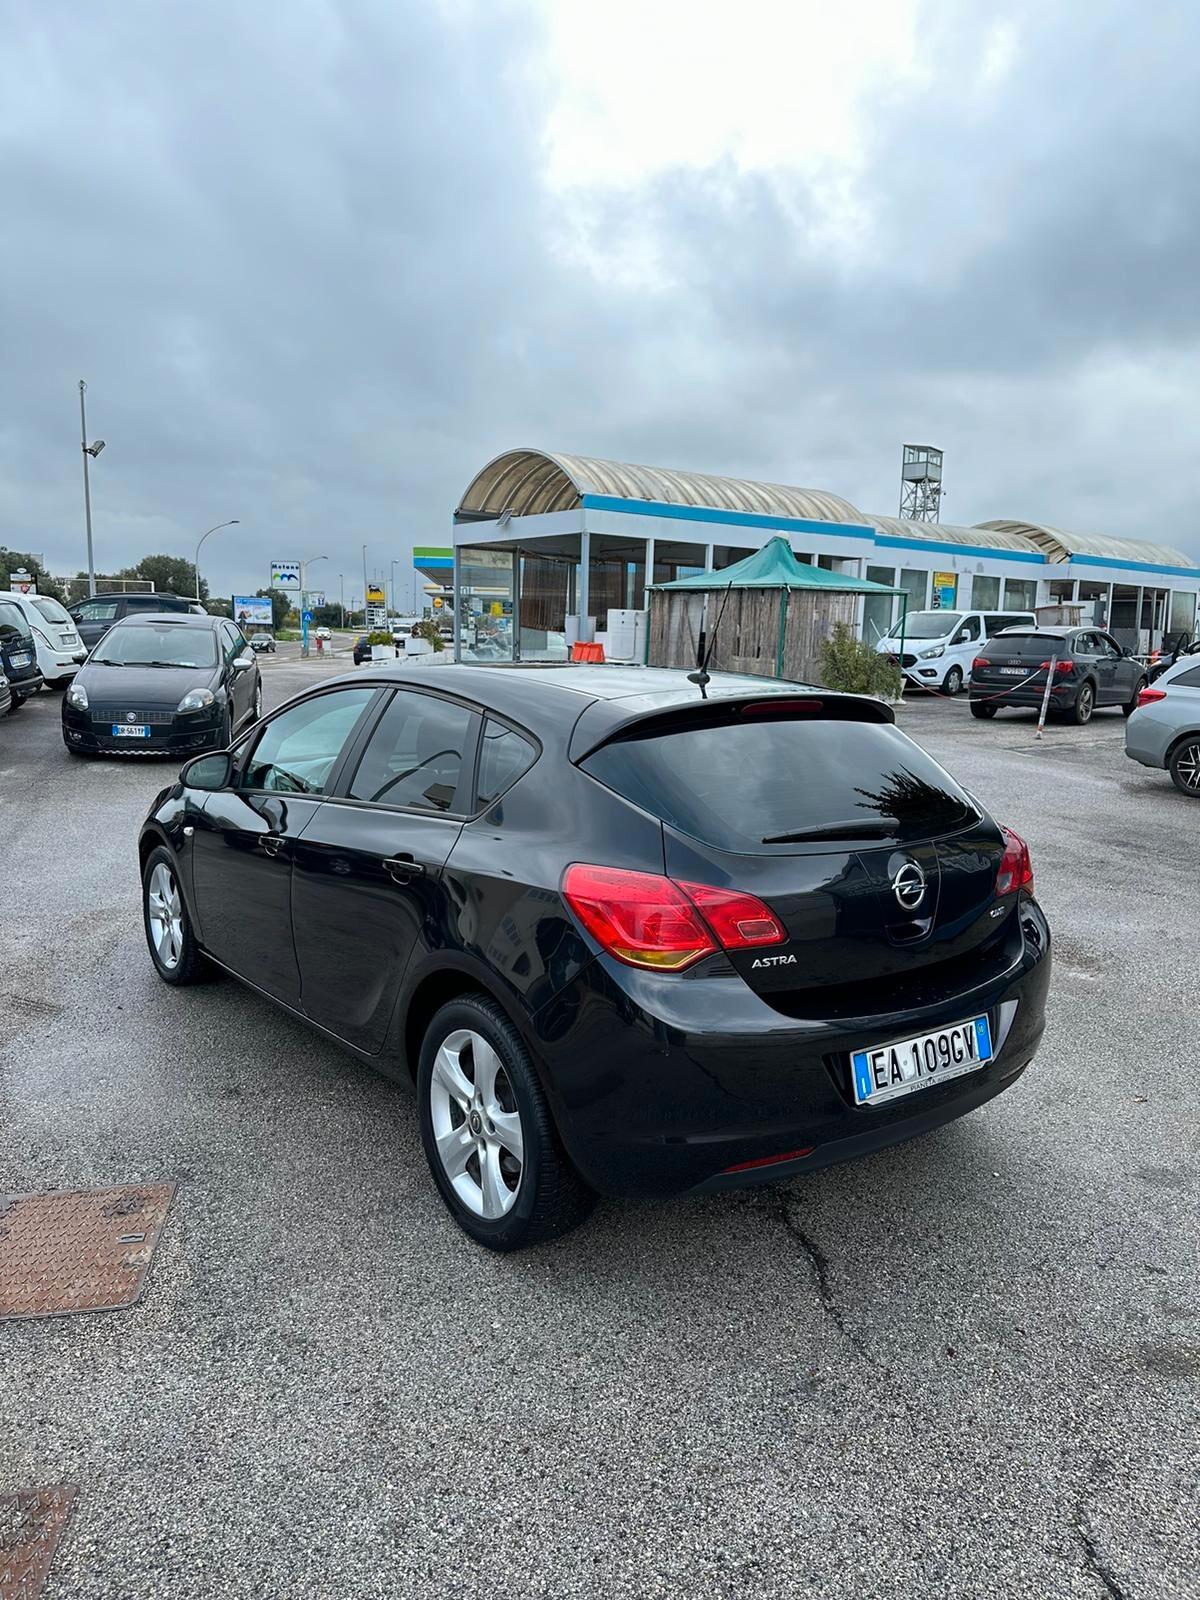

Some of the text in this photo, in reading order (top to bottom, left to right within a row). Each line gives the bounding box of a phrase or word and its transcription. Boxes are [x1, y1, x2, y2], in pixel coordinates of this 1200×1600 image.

[751, 954, 798, 969] ASTRA
[872, 1025, 976, 1090] EA 109GV
